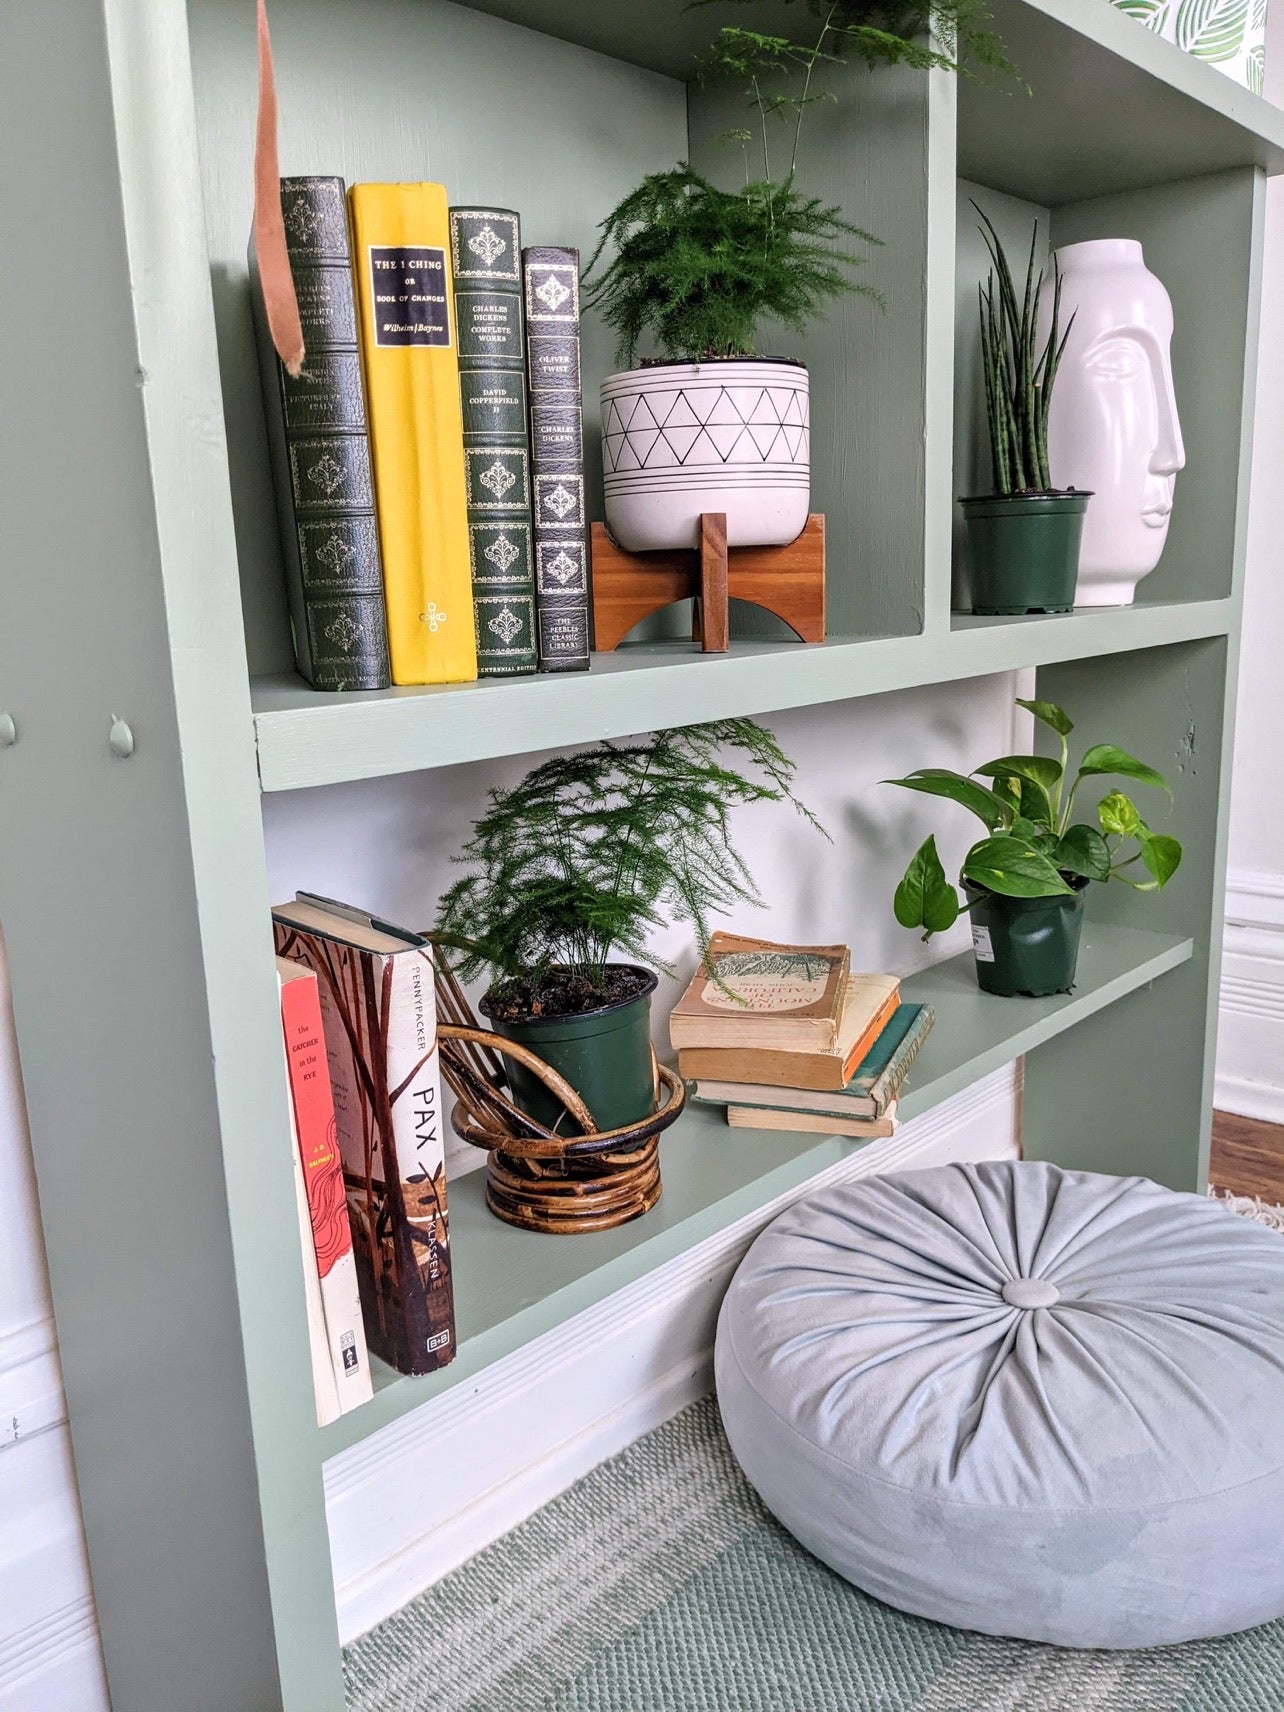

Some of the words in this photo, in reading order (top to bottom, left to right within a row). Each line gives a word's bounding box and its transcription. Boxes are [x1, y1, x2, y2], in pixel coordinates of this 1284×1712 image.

[374, 260, 397, 270] THE
[401, 260, 405, 269] I
[408, 260, 442, 270] CHING
[376, 295, 396, 303] BOOK
[411, 295, 445, 303] CHANGES
[472, 305, 508, 313] CHARLES
[473, 314, 508, 322] DICKENS
[470, 326, 512, 334] COMPLETE
[539, 355, 571, 363] OLIVER
[542, 365, 570, 373] TWIST
[469, 397, 519, 405] COPPERFIELD
[540, 425, 575, 433] CHARLES
[541, 434, 574, 442] DICKENS
[551, 633, 579, 641] CLASSIC
[411, 966, 426, 1051] PENNYPACKER
[297, 1024, 309, 1034] the
[292, 1037, 320, 1052] CATCHER
[299, 1059, 306, 1068] in
[306, 1055, 317, 1065] the
[303, 1070, 317, 1081] RYE
[412, 1086, 438, 1151] PAX
[426, 1220, 440, 1279] KLASSEN
